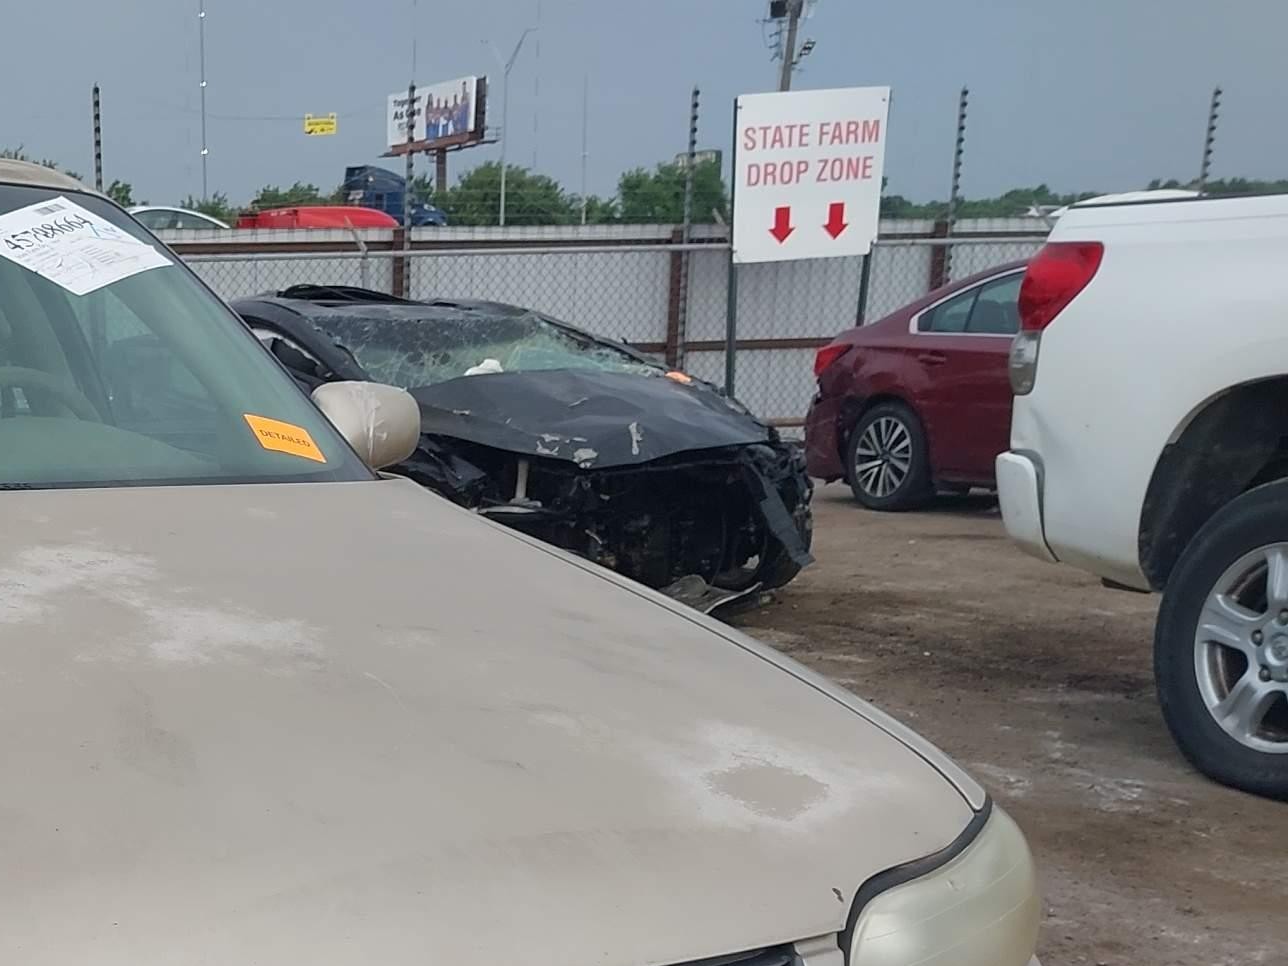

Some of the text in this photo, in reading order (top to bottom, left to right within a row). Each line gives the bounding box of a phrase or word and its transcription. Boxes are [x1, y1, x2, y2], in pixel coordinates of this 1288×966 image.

[744, 120, 880, 151] STATE FARM
[747, 156, 874, 187] DROP ZONE
[259, 429, 310, 447] DETAILED
